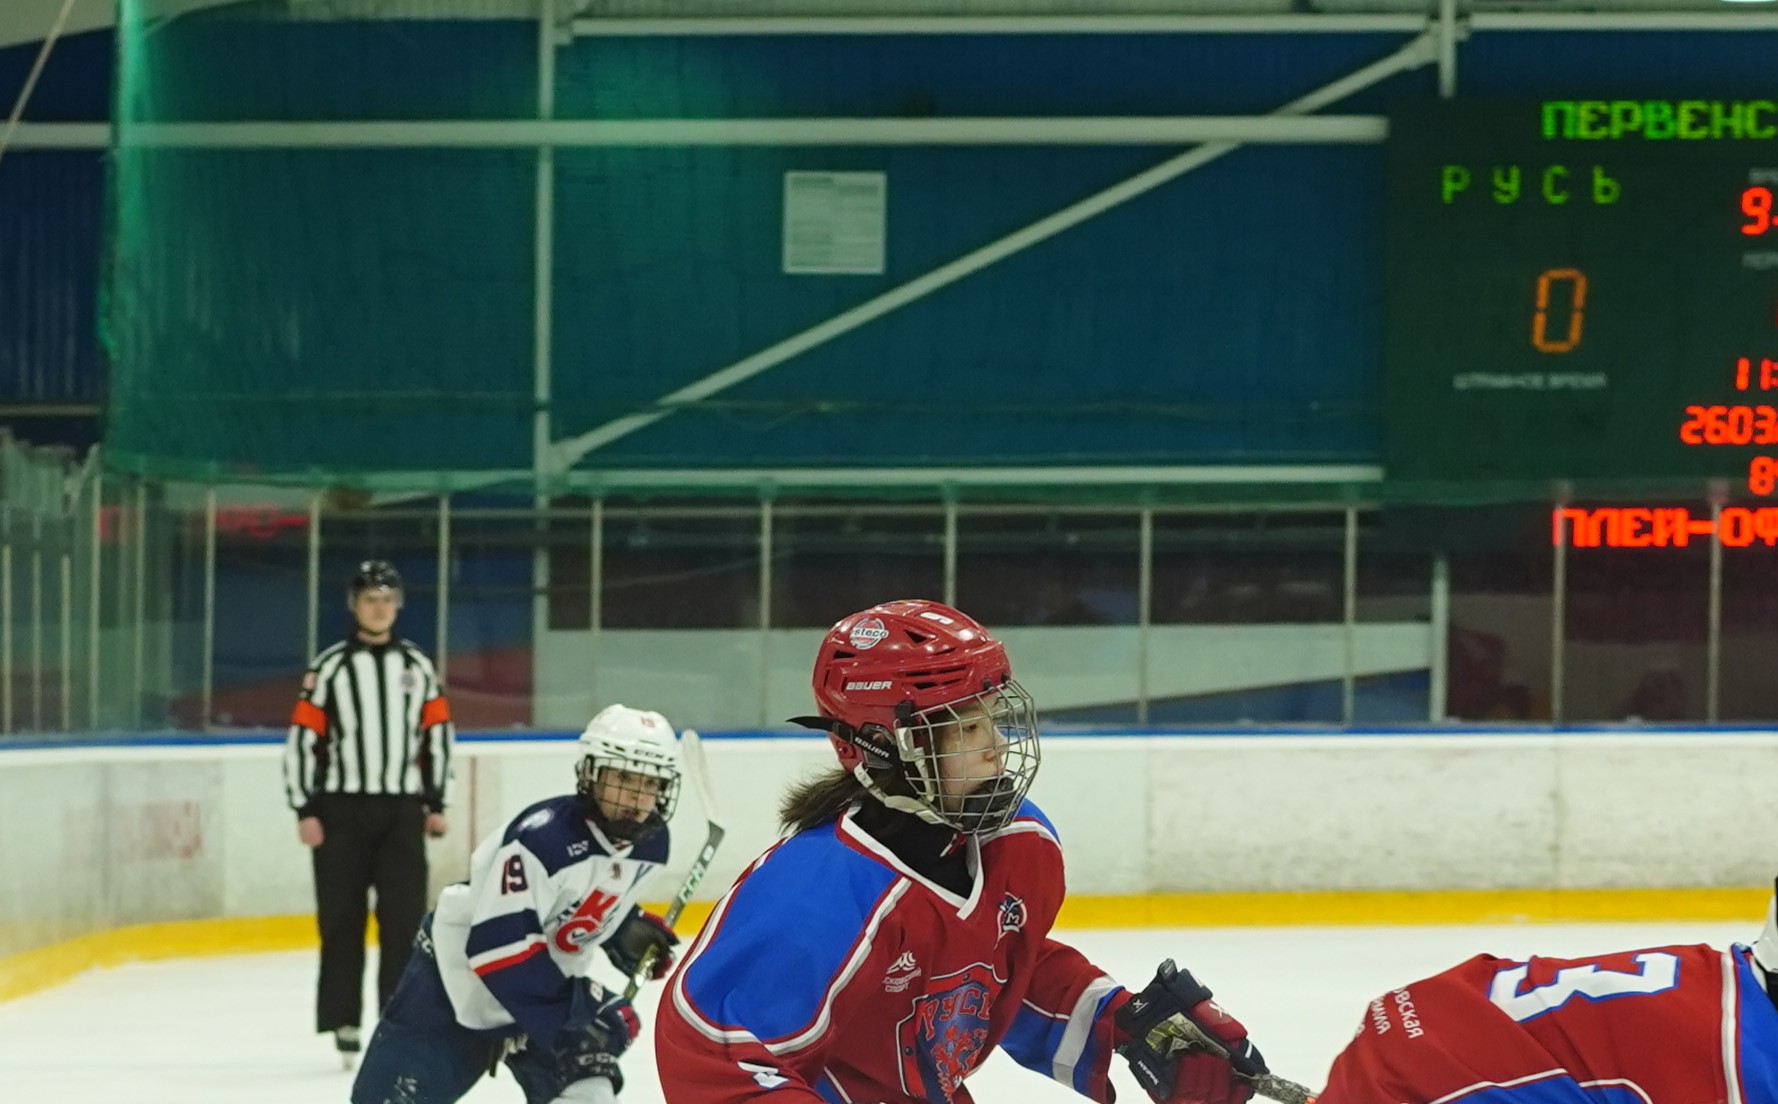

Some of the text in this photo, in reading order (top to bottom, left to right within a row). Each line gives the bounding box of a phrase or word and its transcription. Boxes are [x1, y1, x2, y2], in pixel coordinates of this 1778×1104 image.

[1533, 268, 1588, 352] 0
[846, 680, 893, 692] BAUER
[854, 736, 890, 758] BAUER
[502, 854, 529, 895] 19
